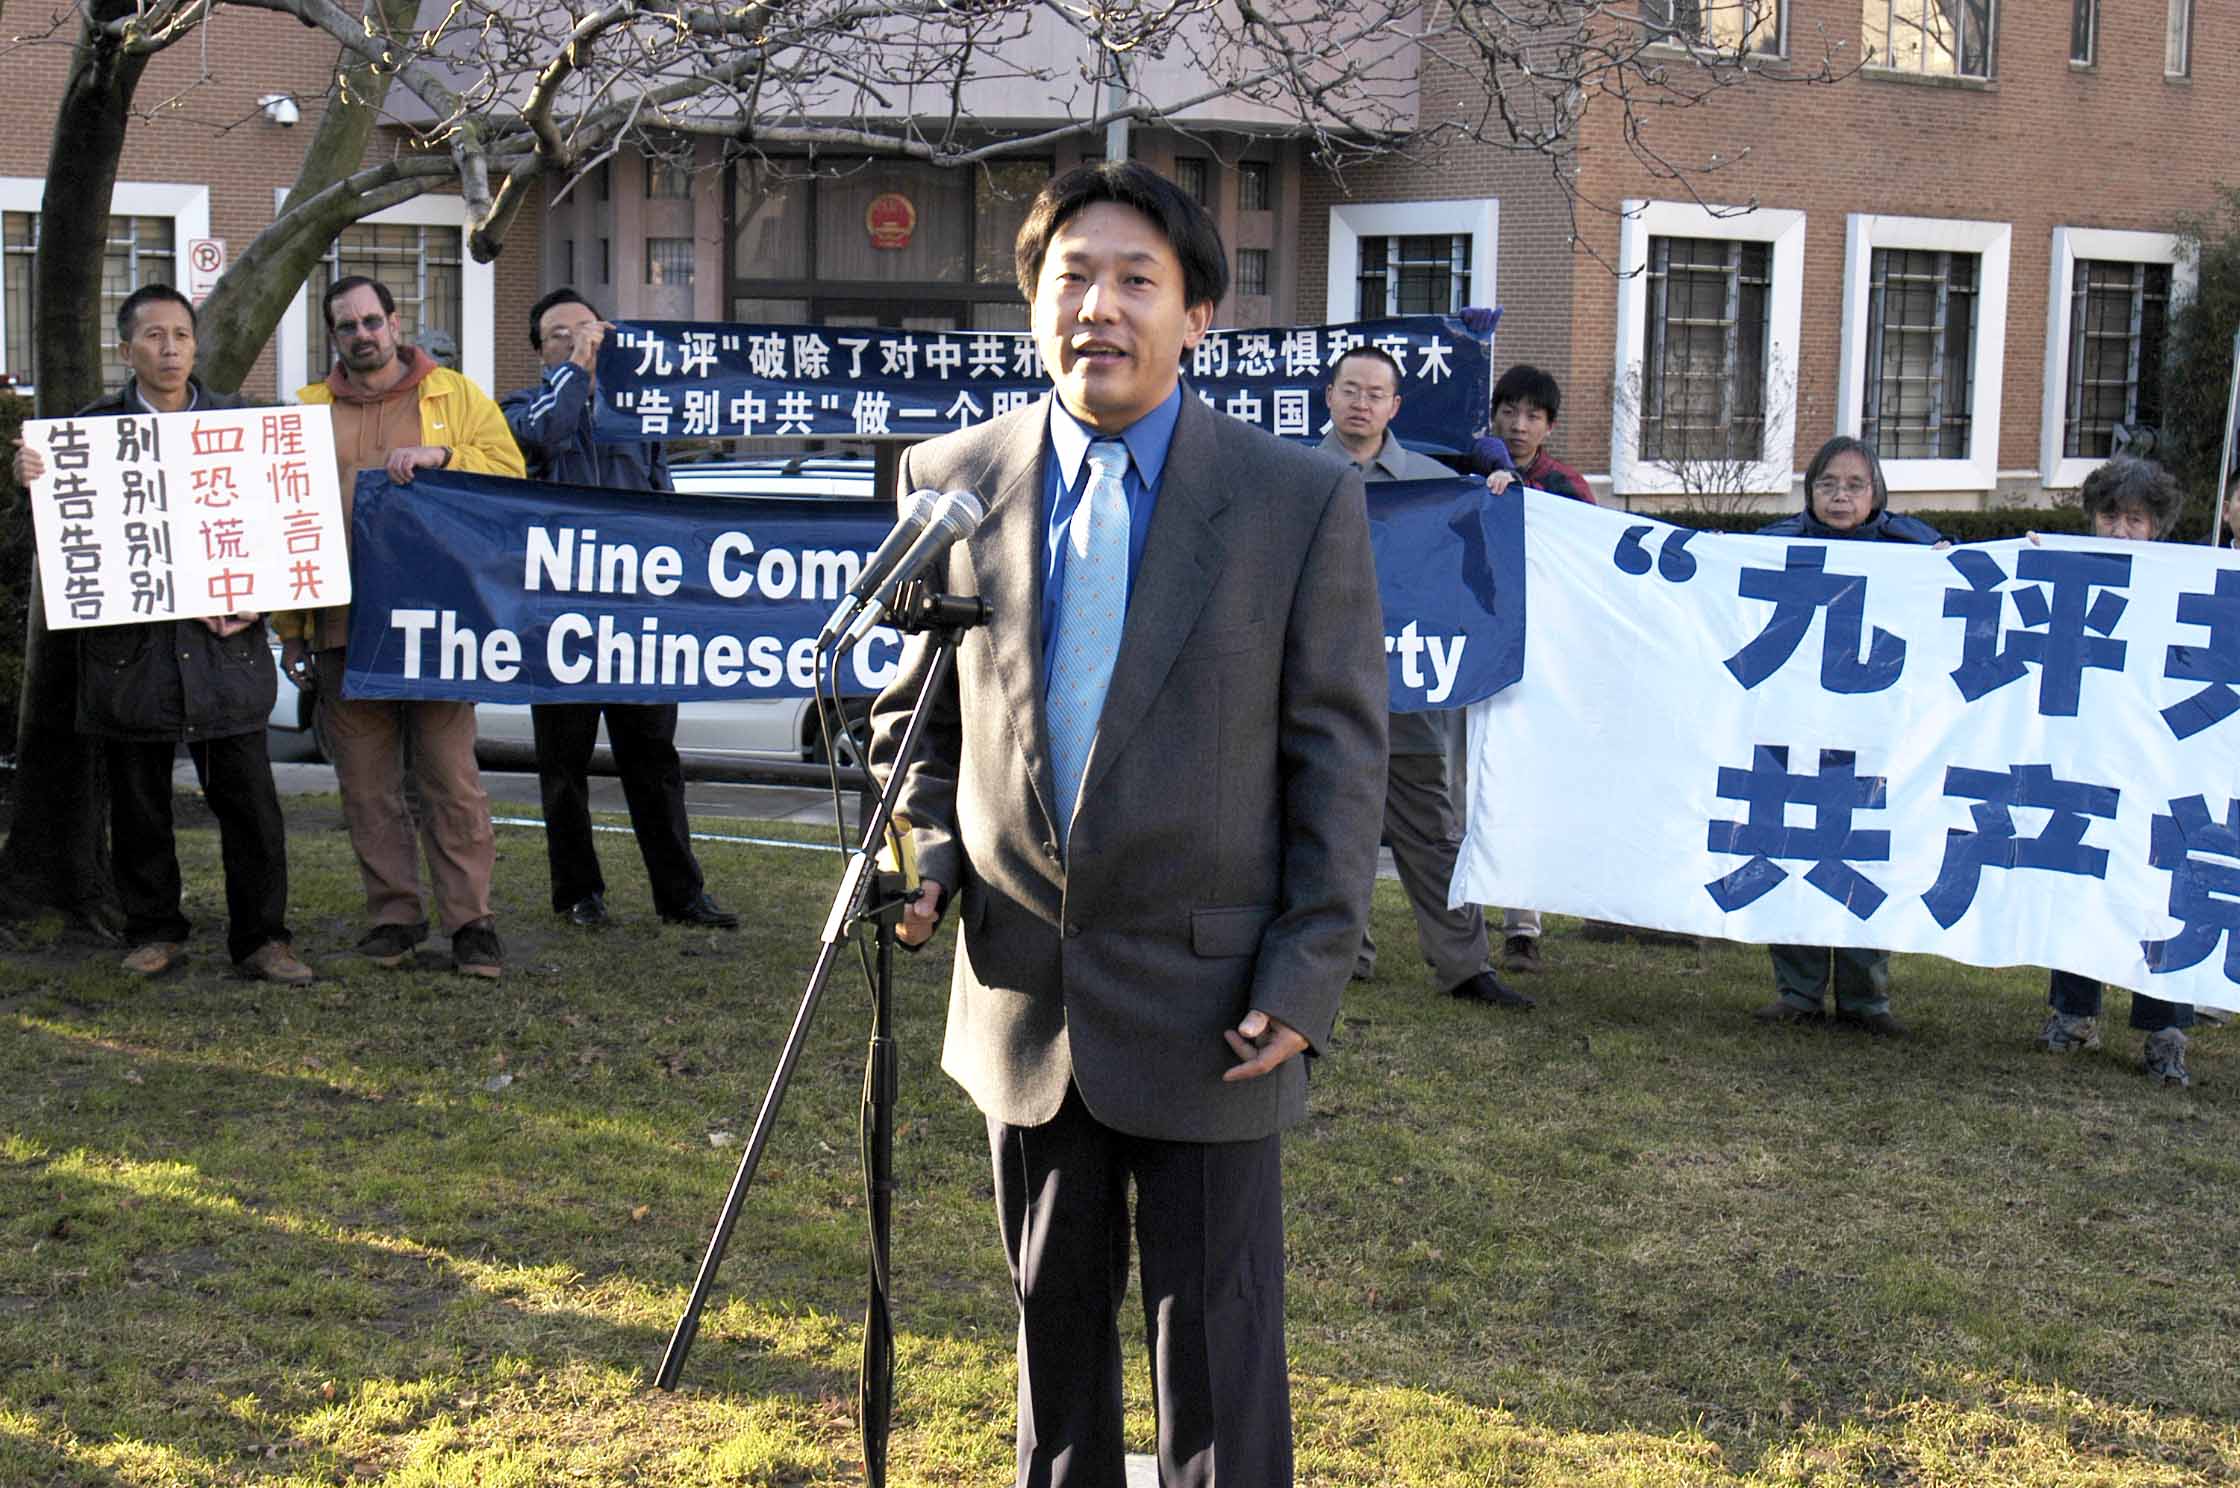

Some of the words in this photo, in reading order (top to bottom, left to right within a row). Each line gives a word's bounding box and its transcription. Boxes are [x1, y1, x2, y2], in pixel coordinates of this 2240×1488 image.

[48, 414, 306, 470] 告别血腥
[53, 461, 310, 520] 告别恐怖
[64, 560, 323, 620] 告别中共
[524, 526, 684, 596] Nine
[708, 531, 880, 600] Com
[390, 609, 522, 683] The
[546, 612, 828, 689] Chinese
[853, 624, 899, 689] C
